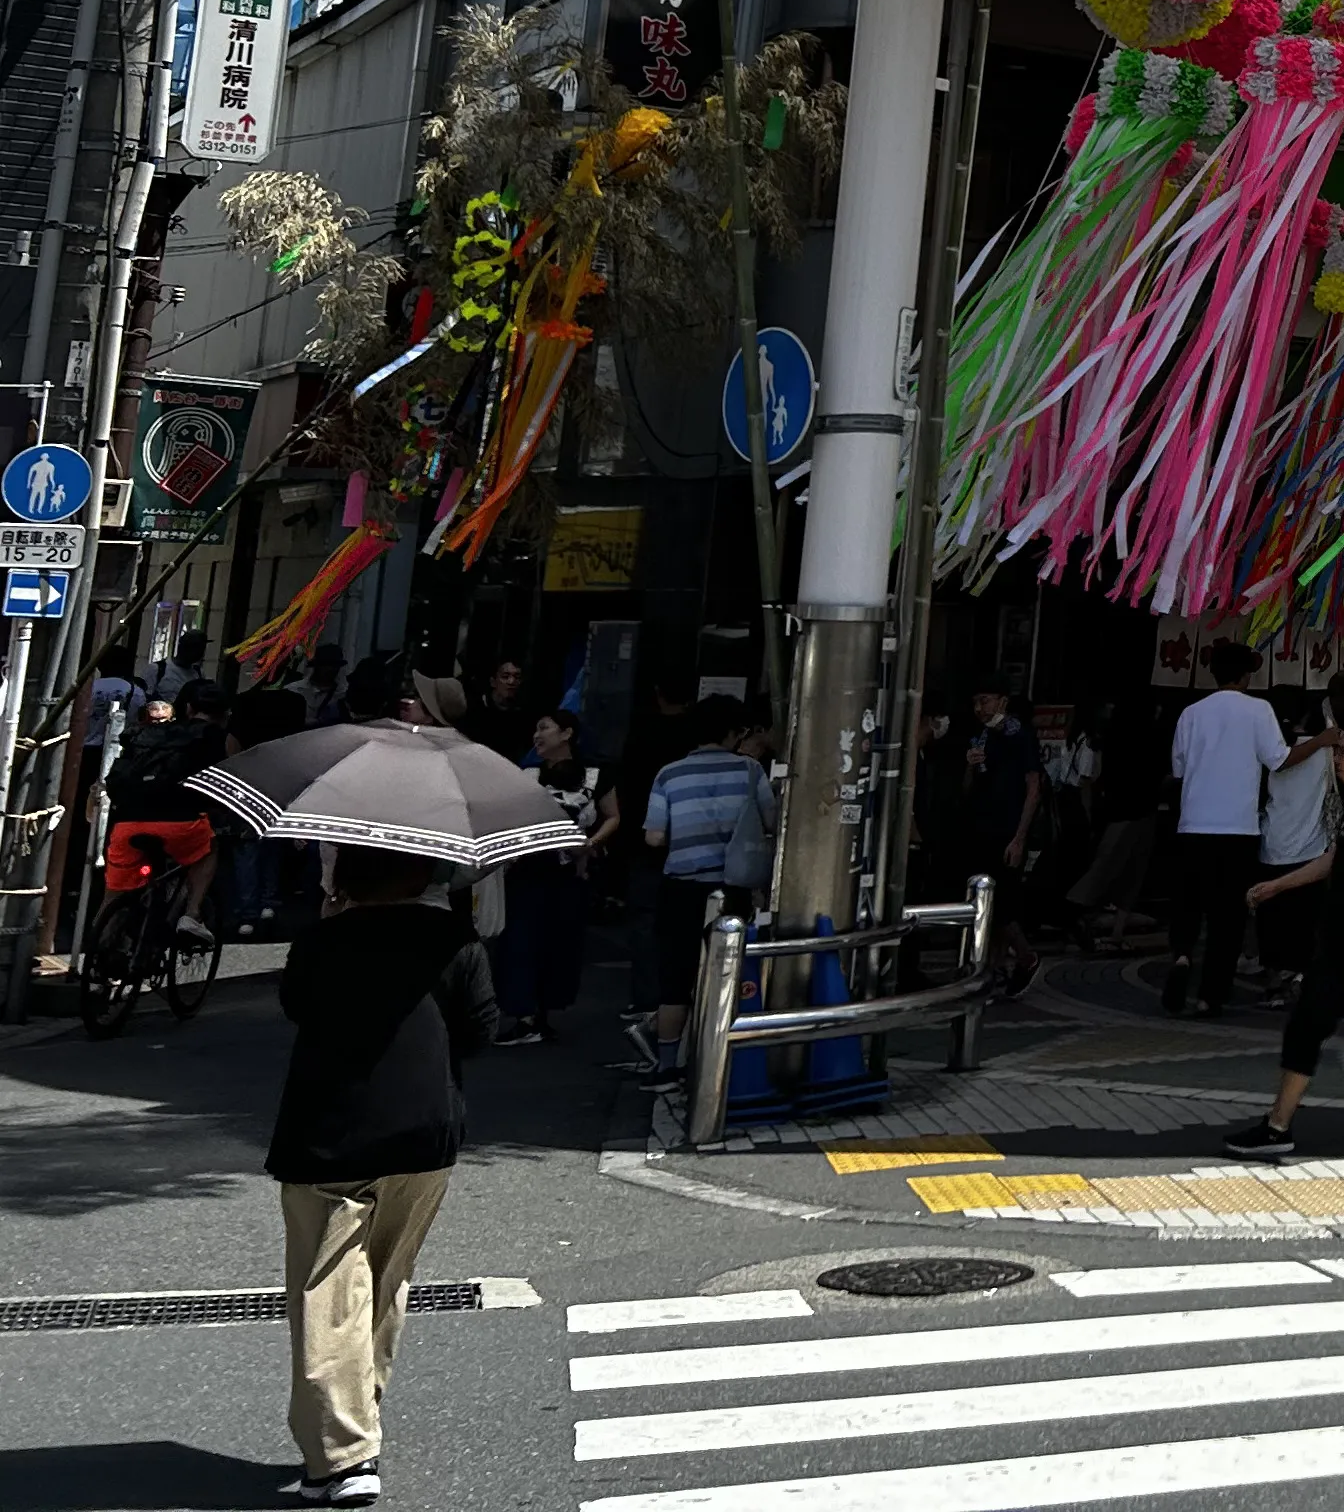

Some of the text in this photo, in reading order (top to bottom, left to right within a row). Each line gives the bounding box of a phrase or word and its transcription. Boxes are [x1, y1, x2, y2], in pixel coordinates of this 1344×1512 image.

[219, 18, 258, 110] 清川病院
[638, 12, 691, 101] 味丸
[203, 119, 237, 133] この先
[198, 139, 258, 156] 3312-0151
[2, 530, 77, 546] 自転車を除く
